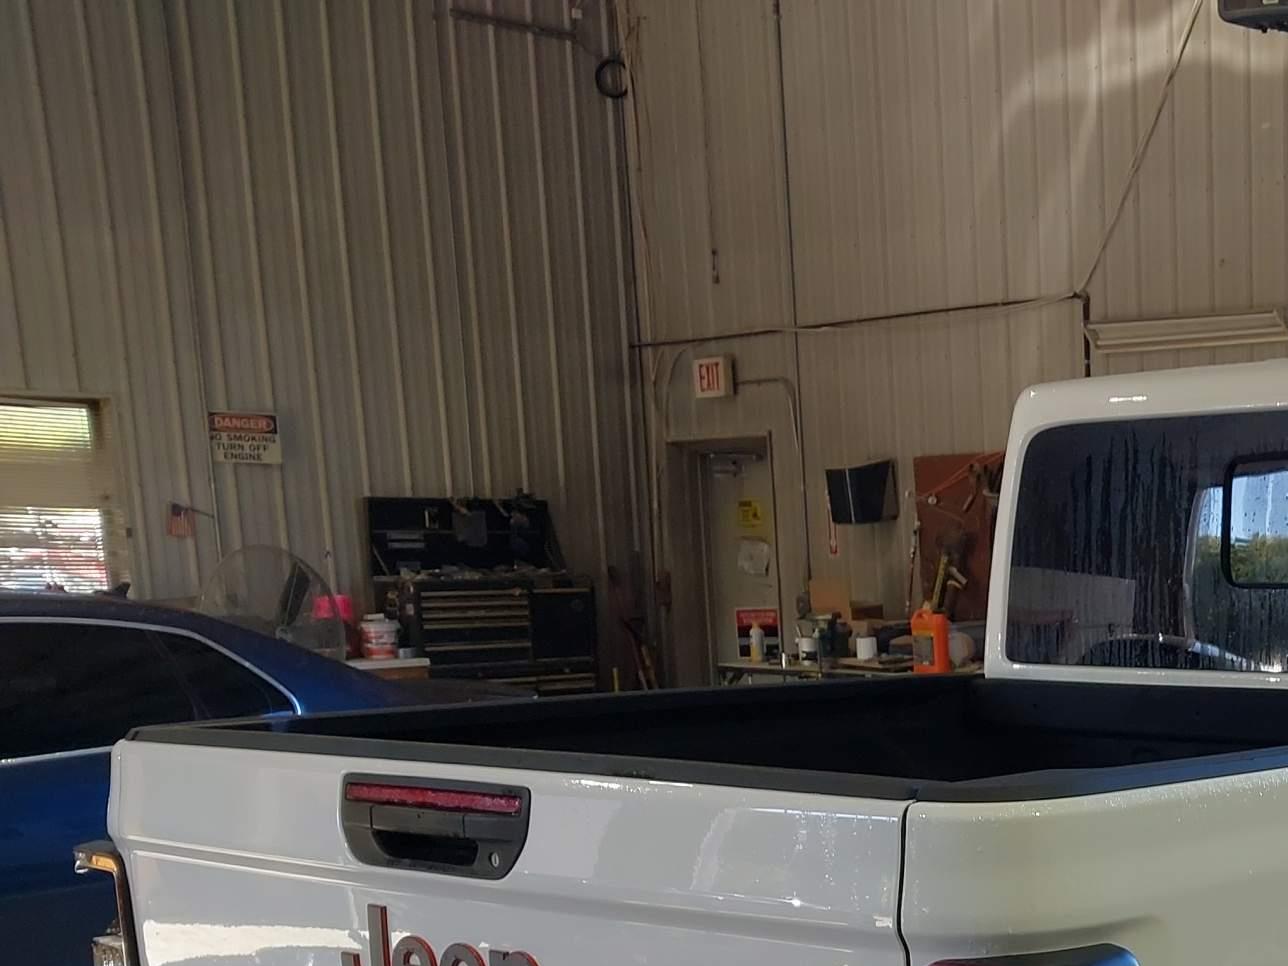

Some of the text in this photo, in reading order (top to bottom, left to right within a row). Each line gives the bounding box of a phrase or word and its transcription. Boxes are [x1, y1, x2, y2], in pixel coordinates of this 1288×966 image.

[698, 361, 721, 392] EXIT
[214, 416, 268, 429] DANGER
[226, 433, 276, 444] SMOKING
[216, 442, 269, 452] TURN OFF
[223, 451, 263, 461] ENGINE
